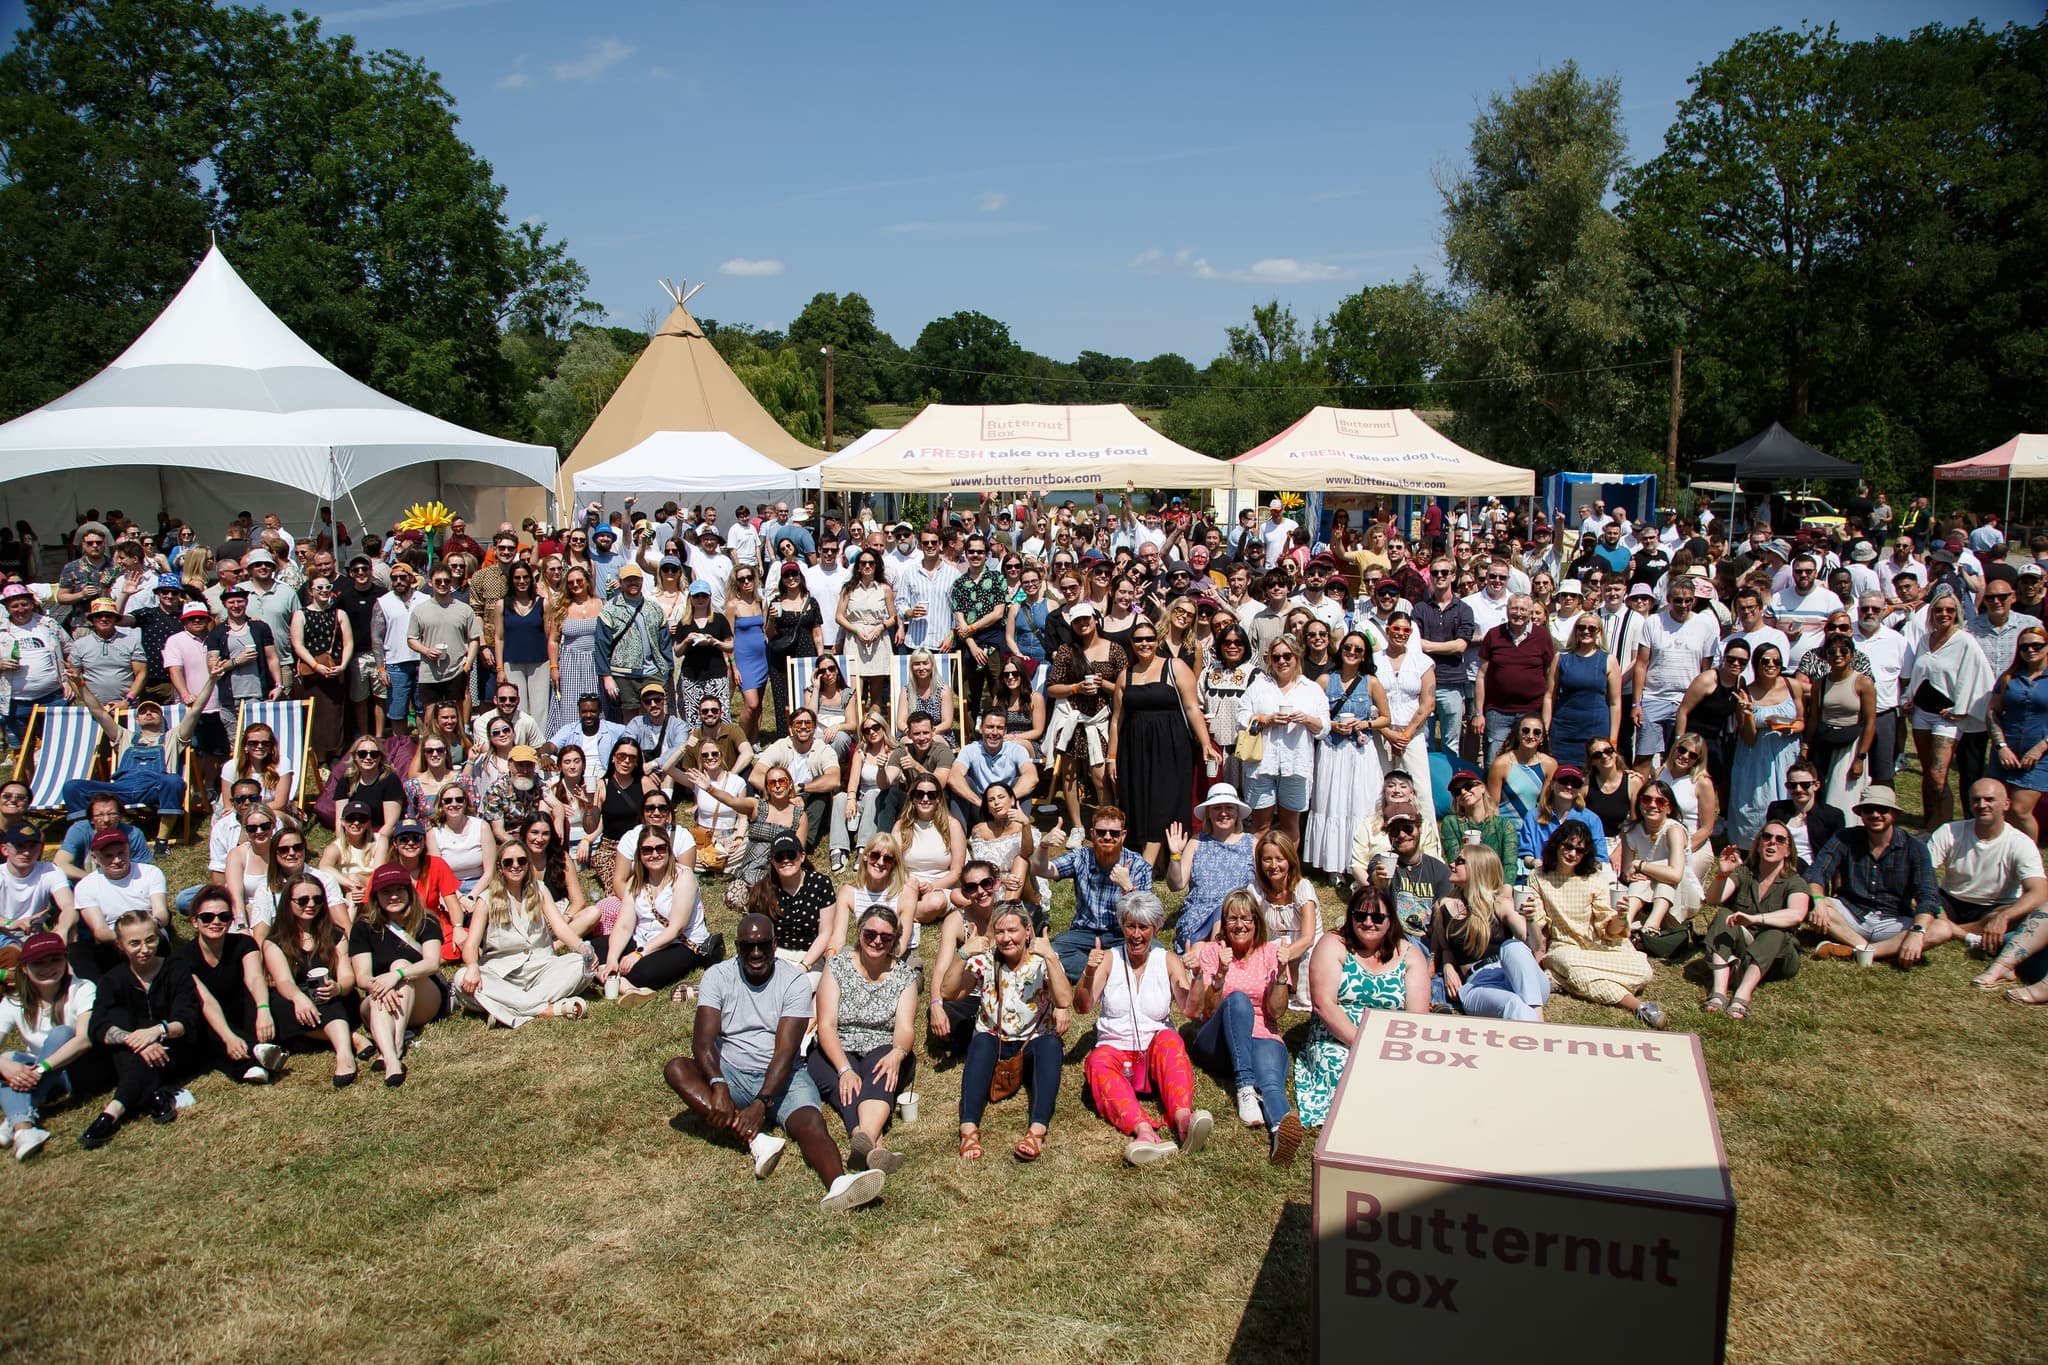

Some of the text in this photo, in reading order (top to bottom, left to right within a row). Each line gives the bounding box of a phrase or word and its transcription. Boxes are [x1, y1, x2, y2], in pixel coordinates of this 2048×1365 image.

[987, 420, 1064, 430] Butternut
[903, 447, 1148, 459] A FRESH take on dog food
[1289, 451, 1299, 459] A
[1349, 453, 1379, 462] take
[1402, 453, 1429, 462] dog
[950, 473, 1102, 487] www.butternutbox.com
[1385, 1019, 1662, 1063] Butternut
[1379, 1040, 1479, 1069] Box
[1345, 1190, 1681, 1288] Butternut
[1345, 1248, 1459, 1313] Box
